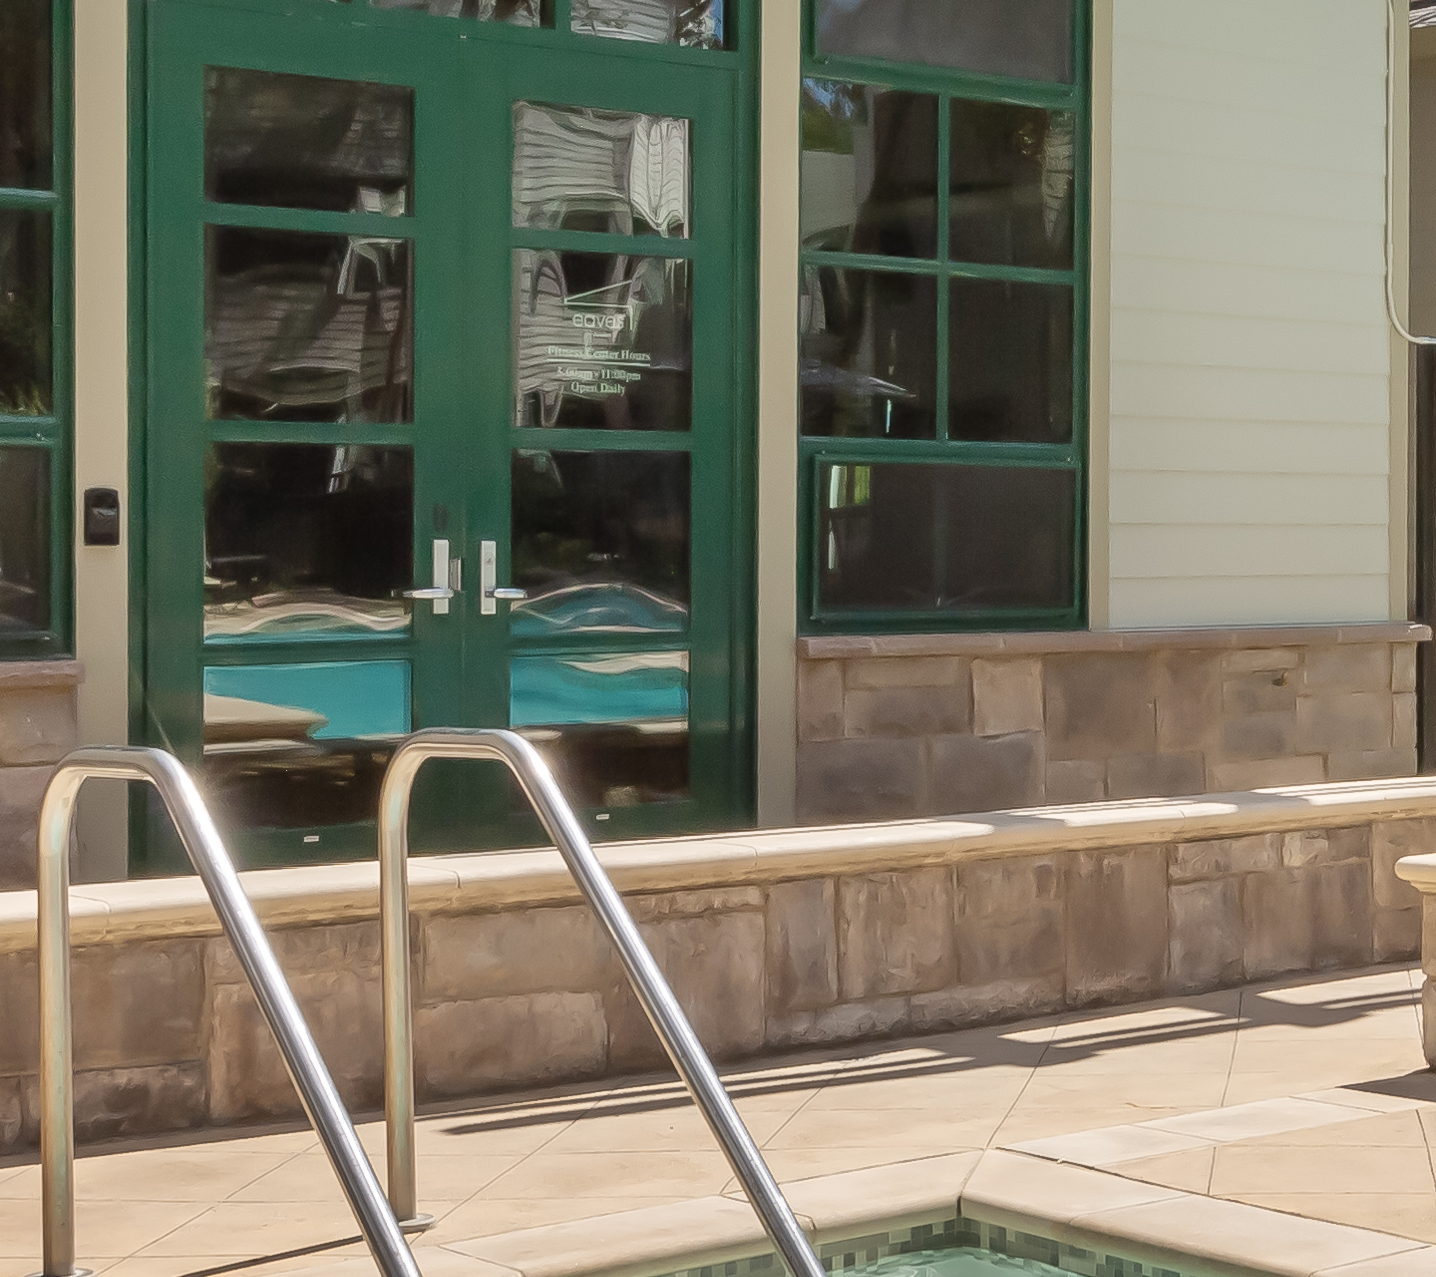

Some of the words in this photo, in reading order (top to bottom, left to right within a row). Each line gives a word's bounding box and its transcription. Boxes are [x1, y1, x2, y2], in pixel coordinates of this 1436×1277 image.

[621, 350, 651, 361] Hours
[571, 381, 598, 393] Open
[600, 383, 625, 396] Daily
